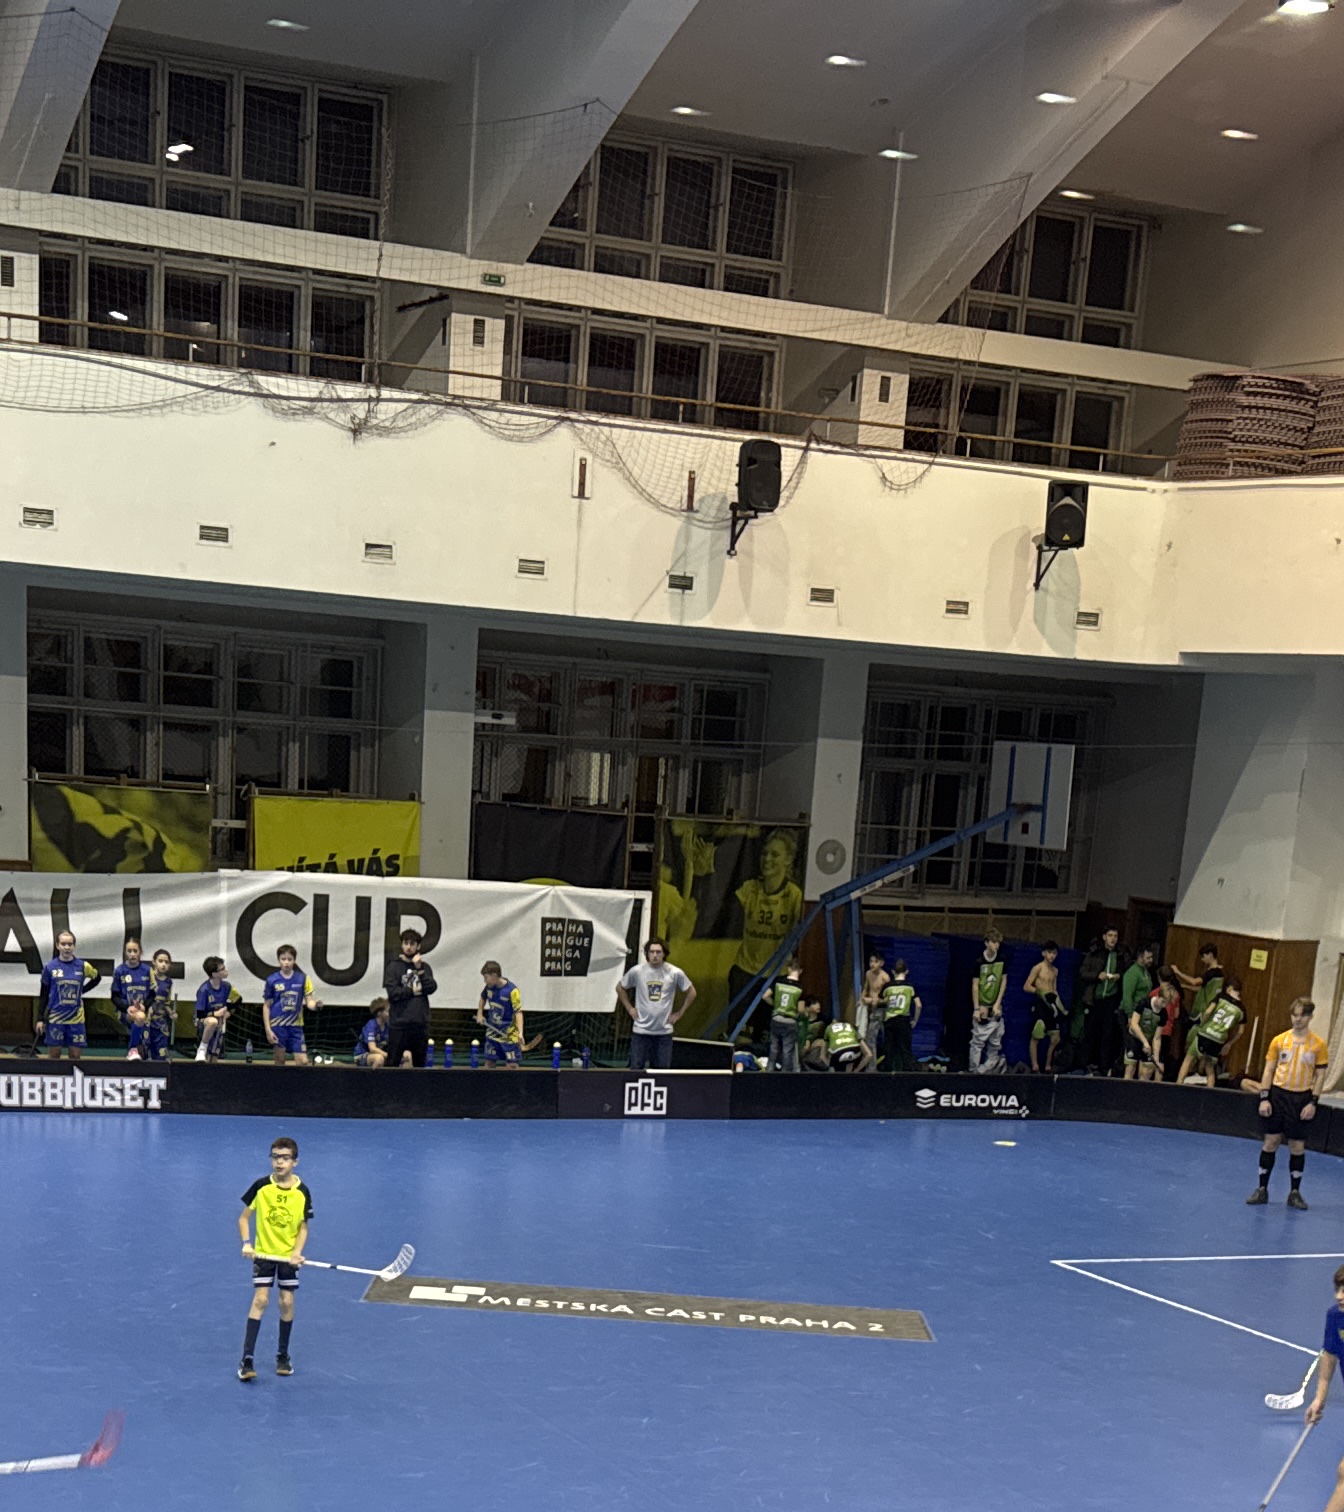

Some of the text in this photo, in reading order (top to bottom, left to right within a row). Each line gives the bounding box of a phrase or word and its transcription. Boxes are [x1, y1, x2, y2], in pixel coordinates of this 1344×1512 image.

[236, 889, 442, 988] CUP
[1212, 1009, 1232, 1030] 24
[939, 1094, 1019, 1108] EUROVIA
[738, 1314, 857, 1331] PRAHA
[868, 1322, 886, 1332] 2
